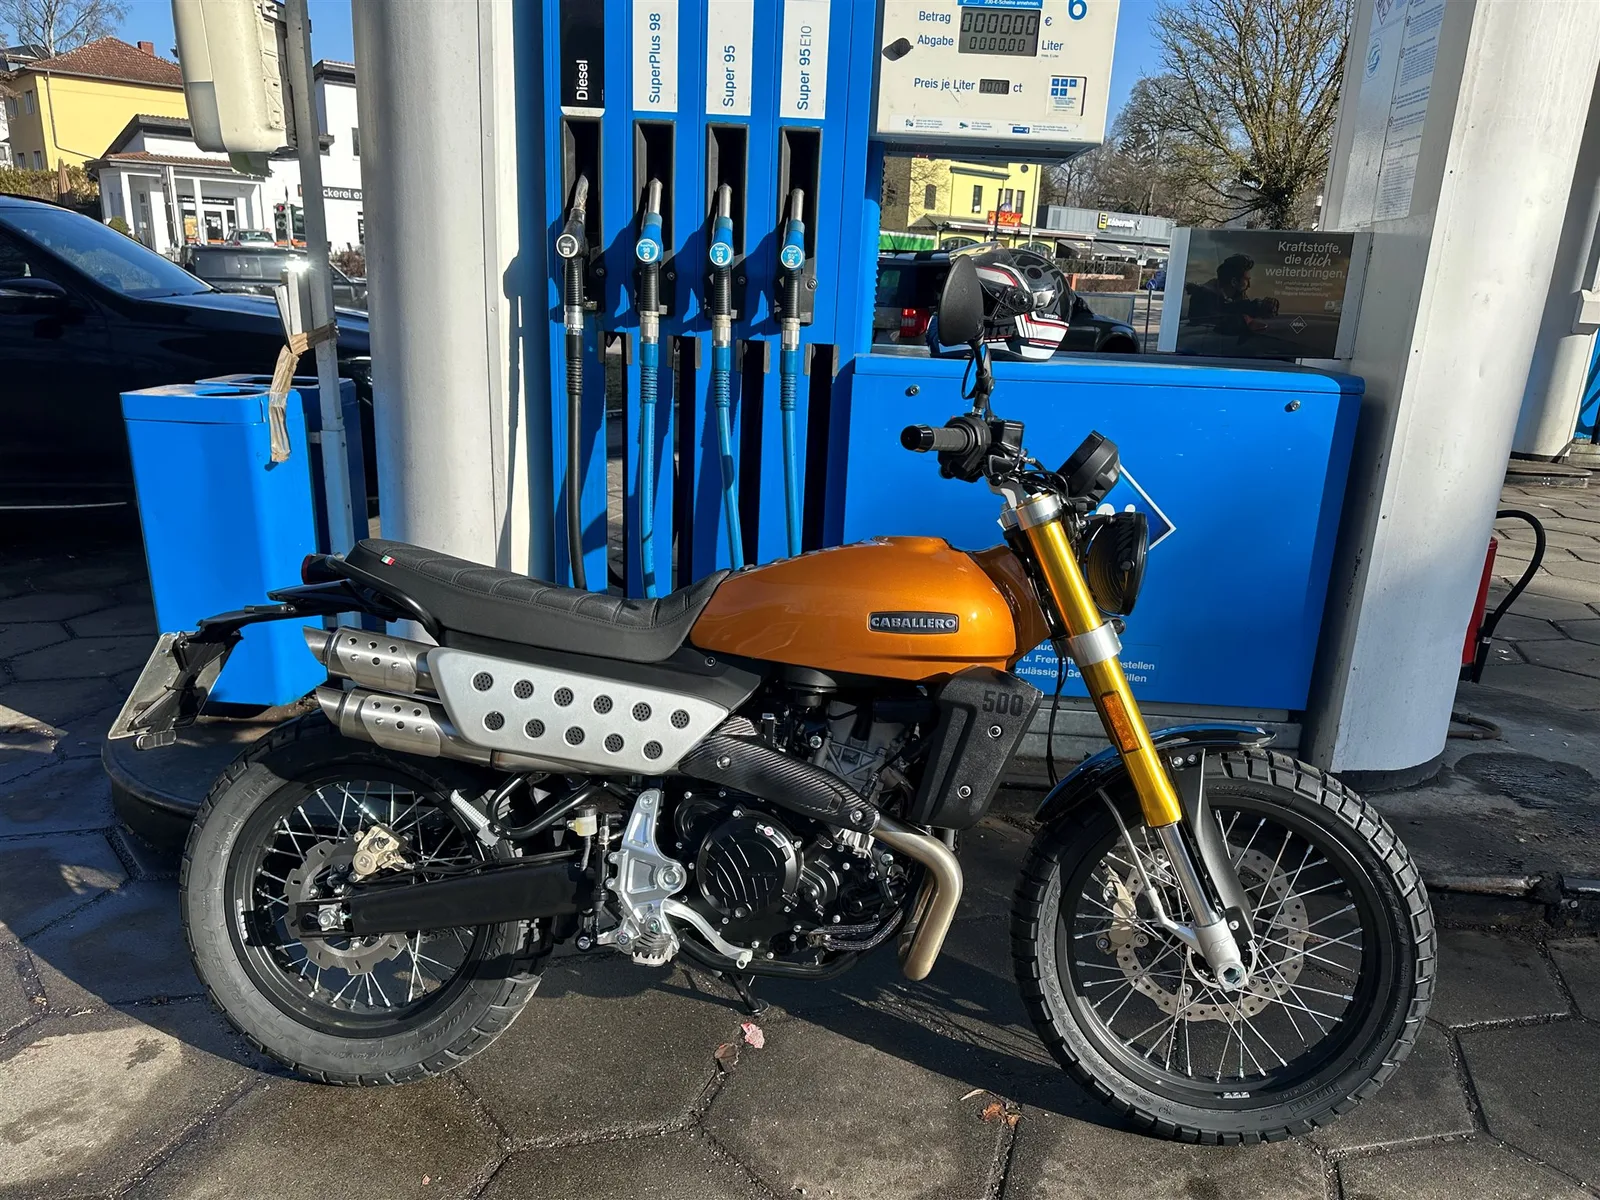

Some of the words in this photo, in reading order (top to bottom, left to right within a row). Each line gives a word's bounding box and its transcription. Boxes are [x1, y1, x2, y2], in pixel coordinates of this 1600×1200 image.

[1068, 0, 1087, 20] 6
[649, 13, 661, 32] 98
[918, 11, 951, 25] Betrag
[1044, 16, 1053, 27] €
[917, 34, 954, 48] Abgabe
[1041, 39, 1064, 52] Liter
[723, 45, 736, 63] 95
[649, 35, 663, 104] SuperPlus
[576, 59, 588, 101] Diesel
[722, 67, 737, 107] Super
[914, 77, 938, 89] Preis
[940, 78, 950, 91] je
[953, 79, 976, 91] Liter
[797, 70, 811, 111] Super
[1013, 84, 1023, 93] ct
[322, 188, 351, 199] ckerei
[1278, 240, 1342, 255] Kraftstoffe,
[1284, 254, 1301, 265] die
[1303, 253, 1332, 267] dich
[1265, 266, 1346, 280] weiterbringen.
[871, 617, 956, 629] CABALLERO
[1022, 654, 1033, 663] u.
[982, 689, 1024, 717] 500
